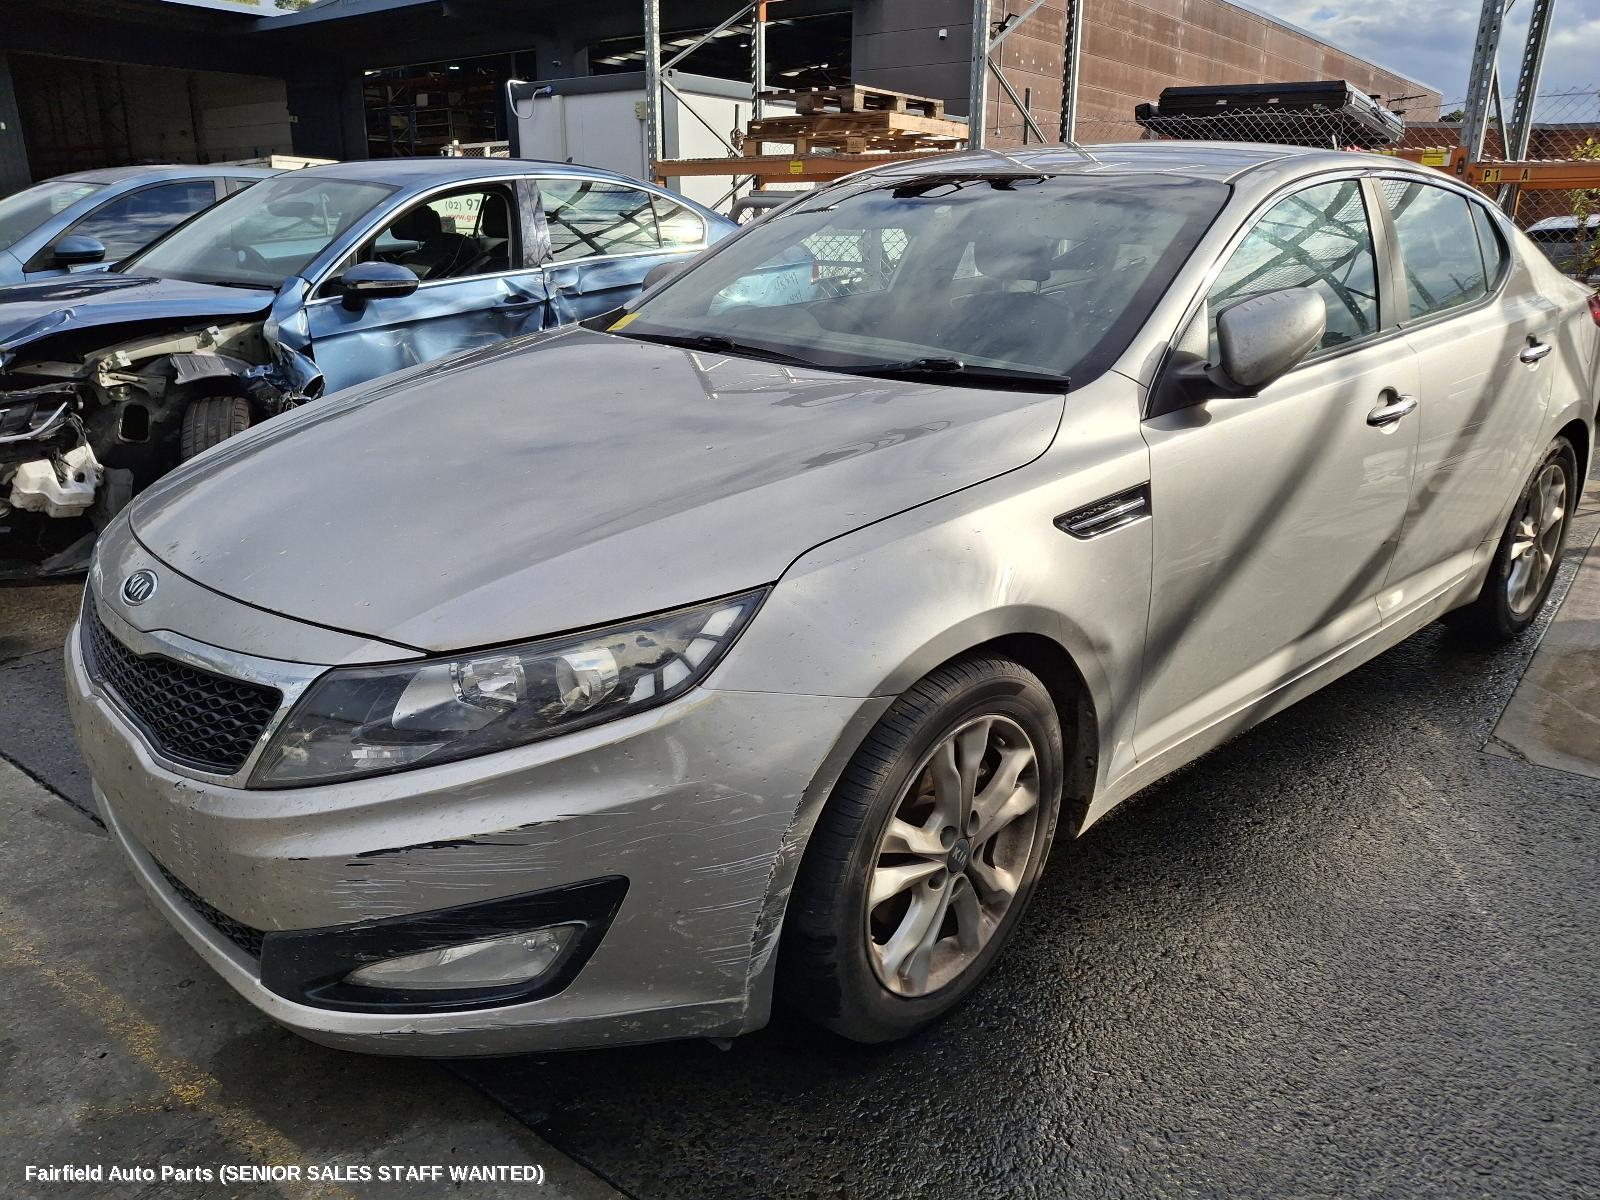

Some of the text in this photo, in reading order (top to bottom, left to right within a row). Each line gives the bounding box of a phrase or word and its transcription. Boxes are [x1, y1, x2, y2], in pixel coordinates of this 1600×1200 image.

[1521, 168, 1529, 181] A
[445, 200, 462, 212] (02)
[128, 573, 151, 600] KIA
[951, 846, 967, 866] KIA
